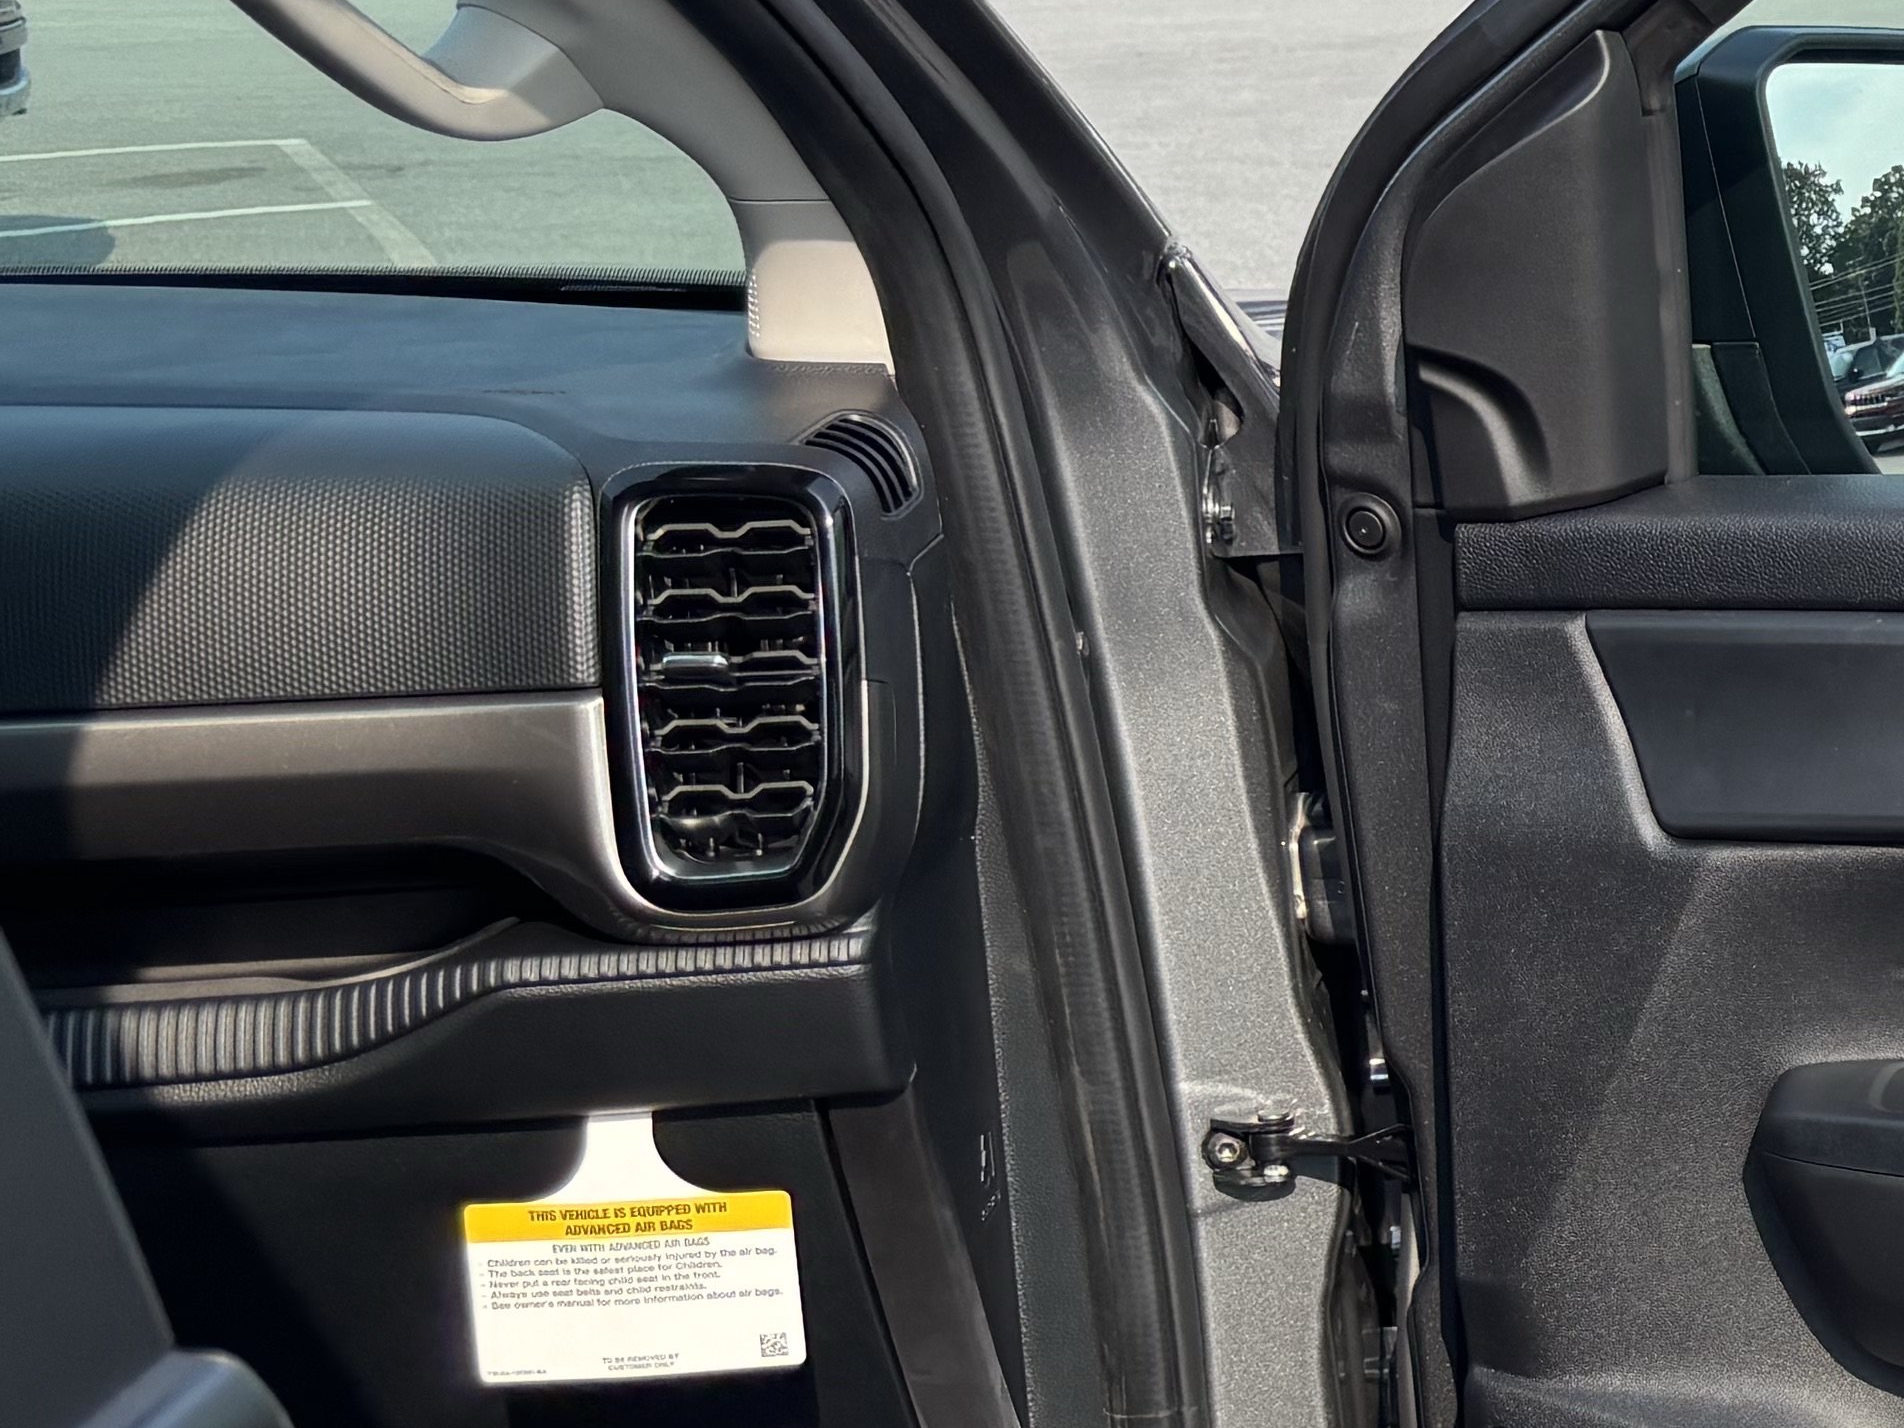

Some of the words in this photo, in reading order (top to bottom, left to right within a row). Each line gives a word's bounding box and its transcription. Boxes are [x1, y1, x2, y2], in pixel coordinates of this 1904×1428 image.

[529, 1210, 556, 1222] THIS
[560, 1208, 610, 1220] VEHICLE
[614, 1208, 626, 1218] IS
[630, 1204, 691, 1217] EQUIPPED
[695, 1202, 726, 1213] WITH
[565, 1223, 630, 1236] ADVANCED
[635, 1222, 655, 1232] AIR
[660, 1219, 693, 1230] BAGS
[553, 1243, 576, 1253] EVEN
[580, 1243, 604, 1252] WITH
[609, 1240, 660, 1251] ADVANCED
[665, 1239, 680, 1248] AIR
[685, 1237, 710, 1246] BAGS
[487, 1258, 530, 1268] Children
[534, 1258, 552, 1266] can
[571, 1256, 597, 1265] killed
[614, 1253, 661, 1264] seriously
[665, 1251, 701, 1261] injured
[720, 1249, 736, 1257] the
[755, 1247, 777, 1256] bag.
[488, 1270, 507, 1278] The
[511, 1269, 535, 1277] back
[574, 1267, 589, 1275] the
[627, 1264, 655, 1274] place
[658, 1263, 672, 1271] for
[490, 1280, 519, 1288] Never
[522, 1280, 539, 1289] put
[574, 1277, 604, 1287] facing
[608, 1276, 633, 1285] child
[552, 1289, 573, 1297] seat
[576, 1287, 600, 1296] belts
[604, 1287, 622, 1295] and
[626, 1286, 651, 1294] child
[492, 1302, 510, 1310] See
[557, 1298, 594, 1308] manual
[597, 1297, 610, 1306] for
[614, 1297, 640, 1305] more
[644, 1293, 704, 1304] information
[707, 1291, 736, 1299] about
